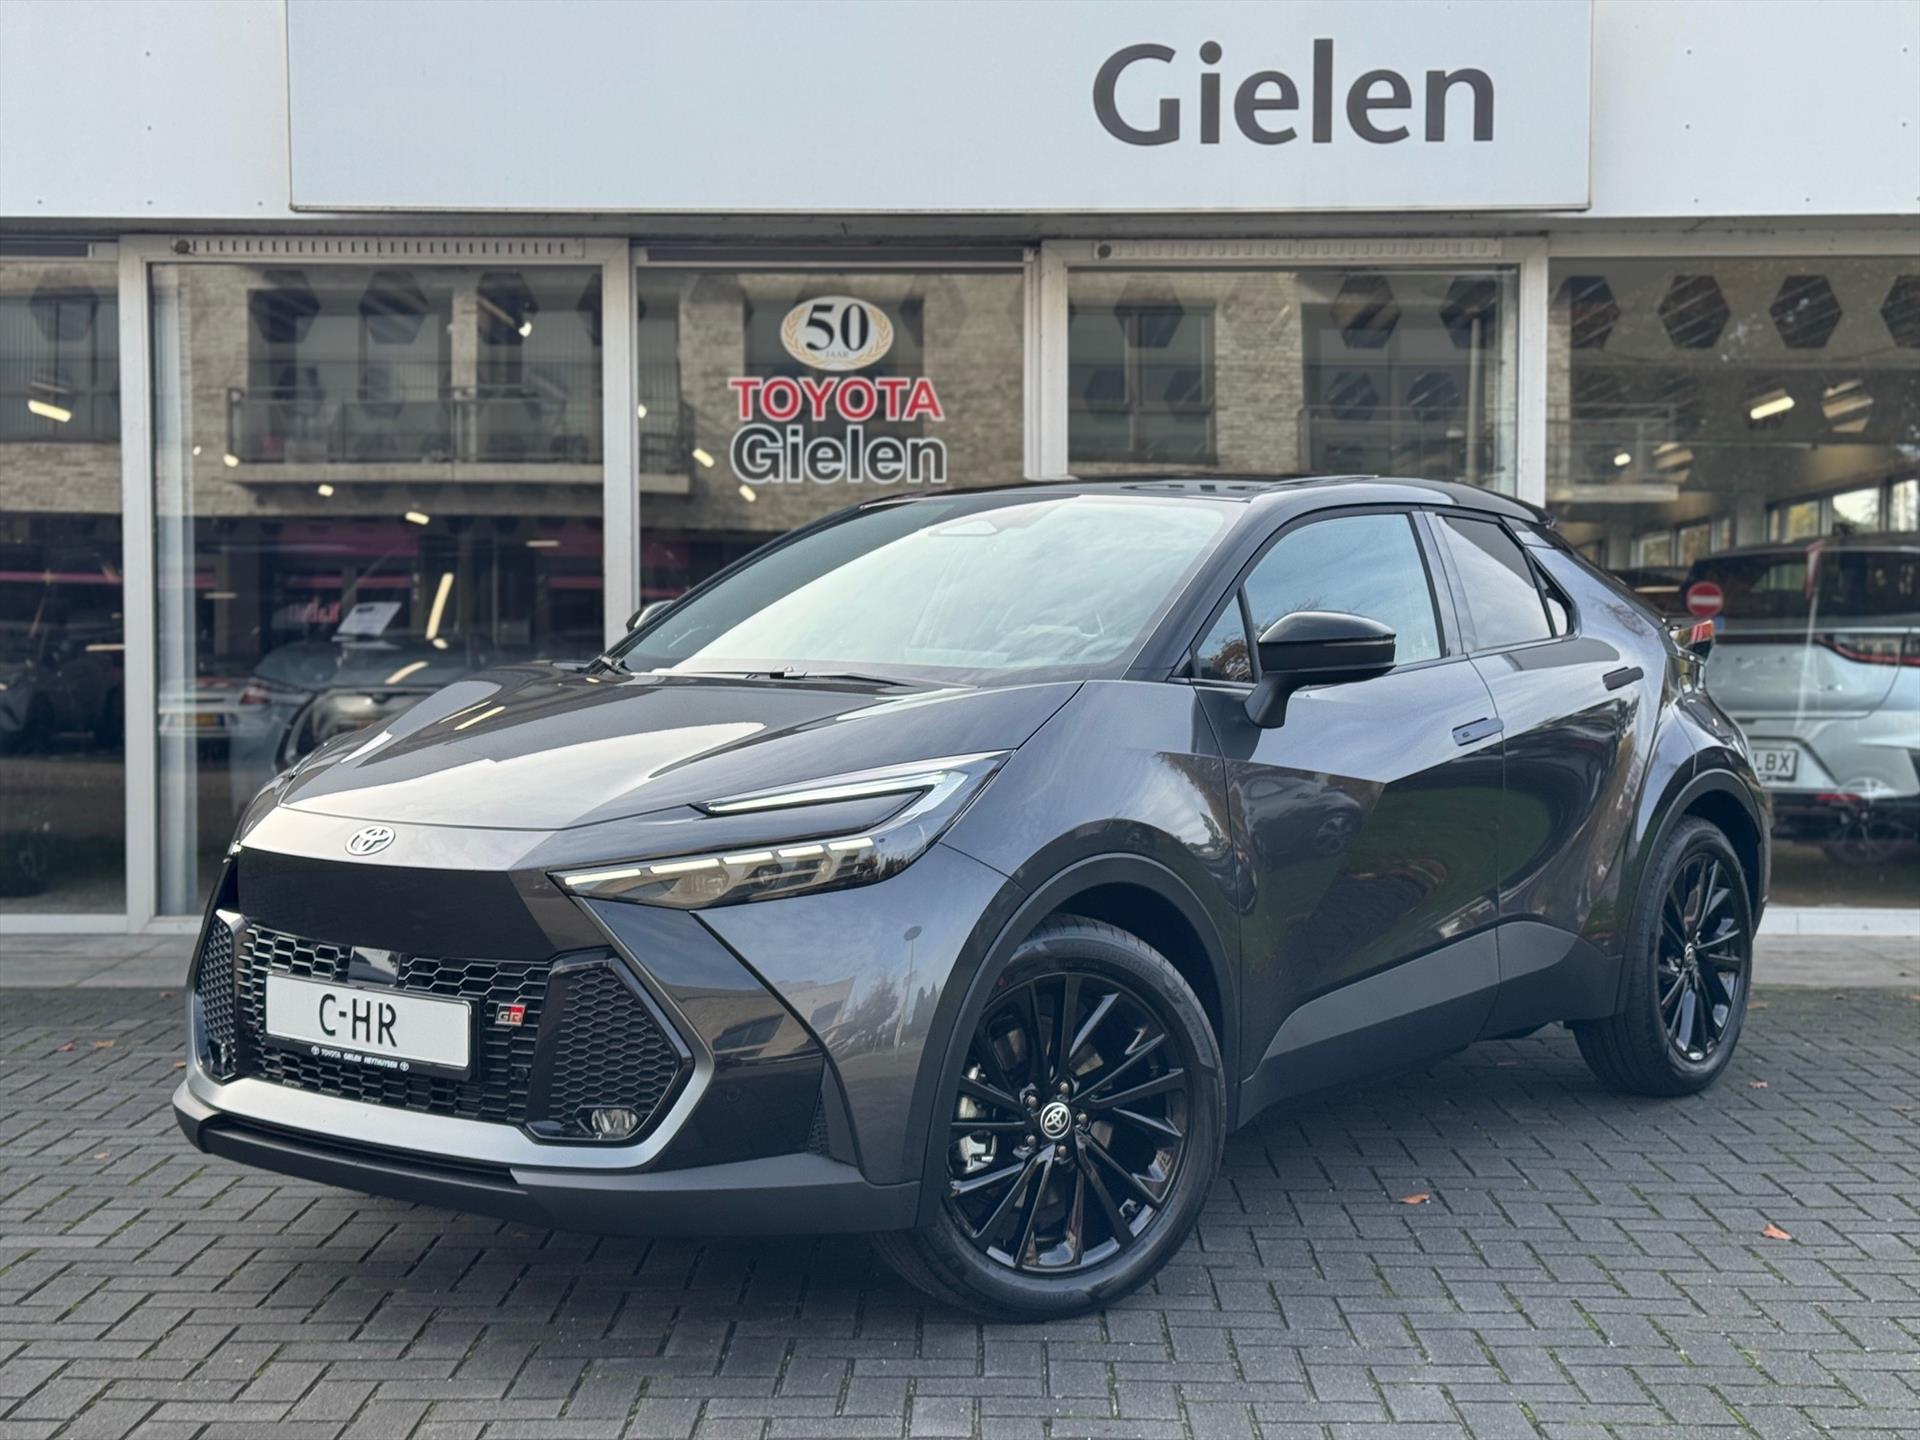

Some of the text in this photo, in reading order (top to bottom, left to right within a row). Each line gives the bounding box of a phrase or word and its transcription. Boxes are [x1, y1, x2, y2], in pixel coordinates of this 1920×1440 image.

[1093, 38, 1494, 146] Gielen
[806, 303, 869, 351] 50
[729, 377, 945, 421] TOYOTA
[730, 423, 947, 484] Gielen
[319, 993, 397, 1047] C-HR
[497, 1010, 523, 1023] GR
[321, 1048, 341, 1058] TOYOTA
